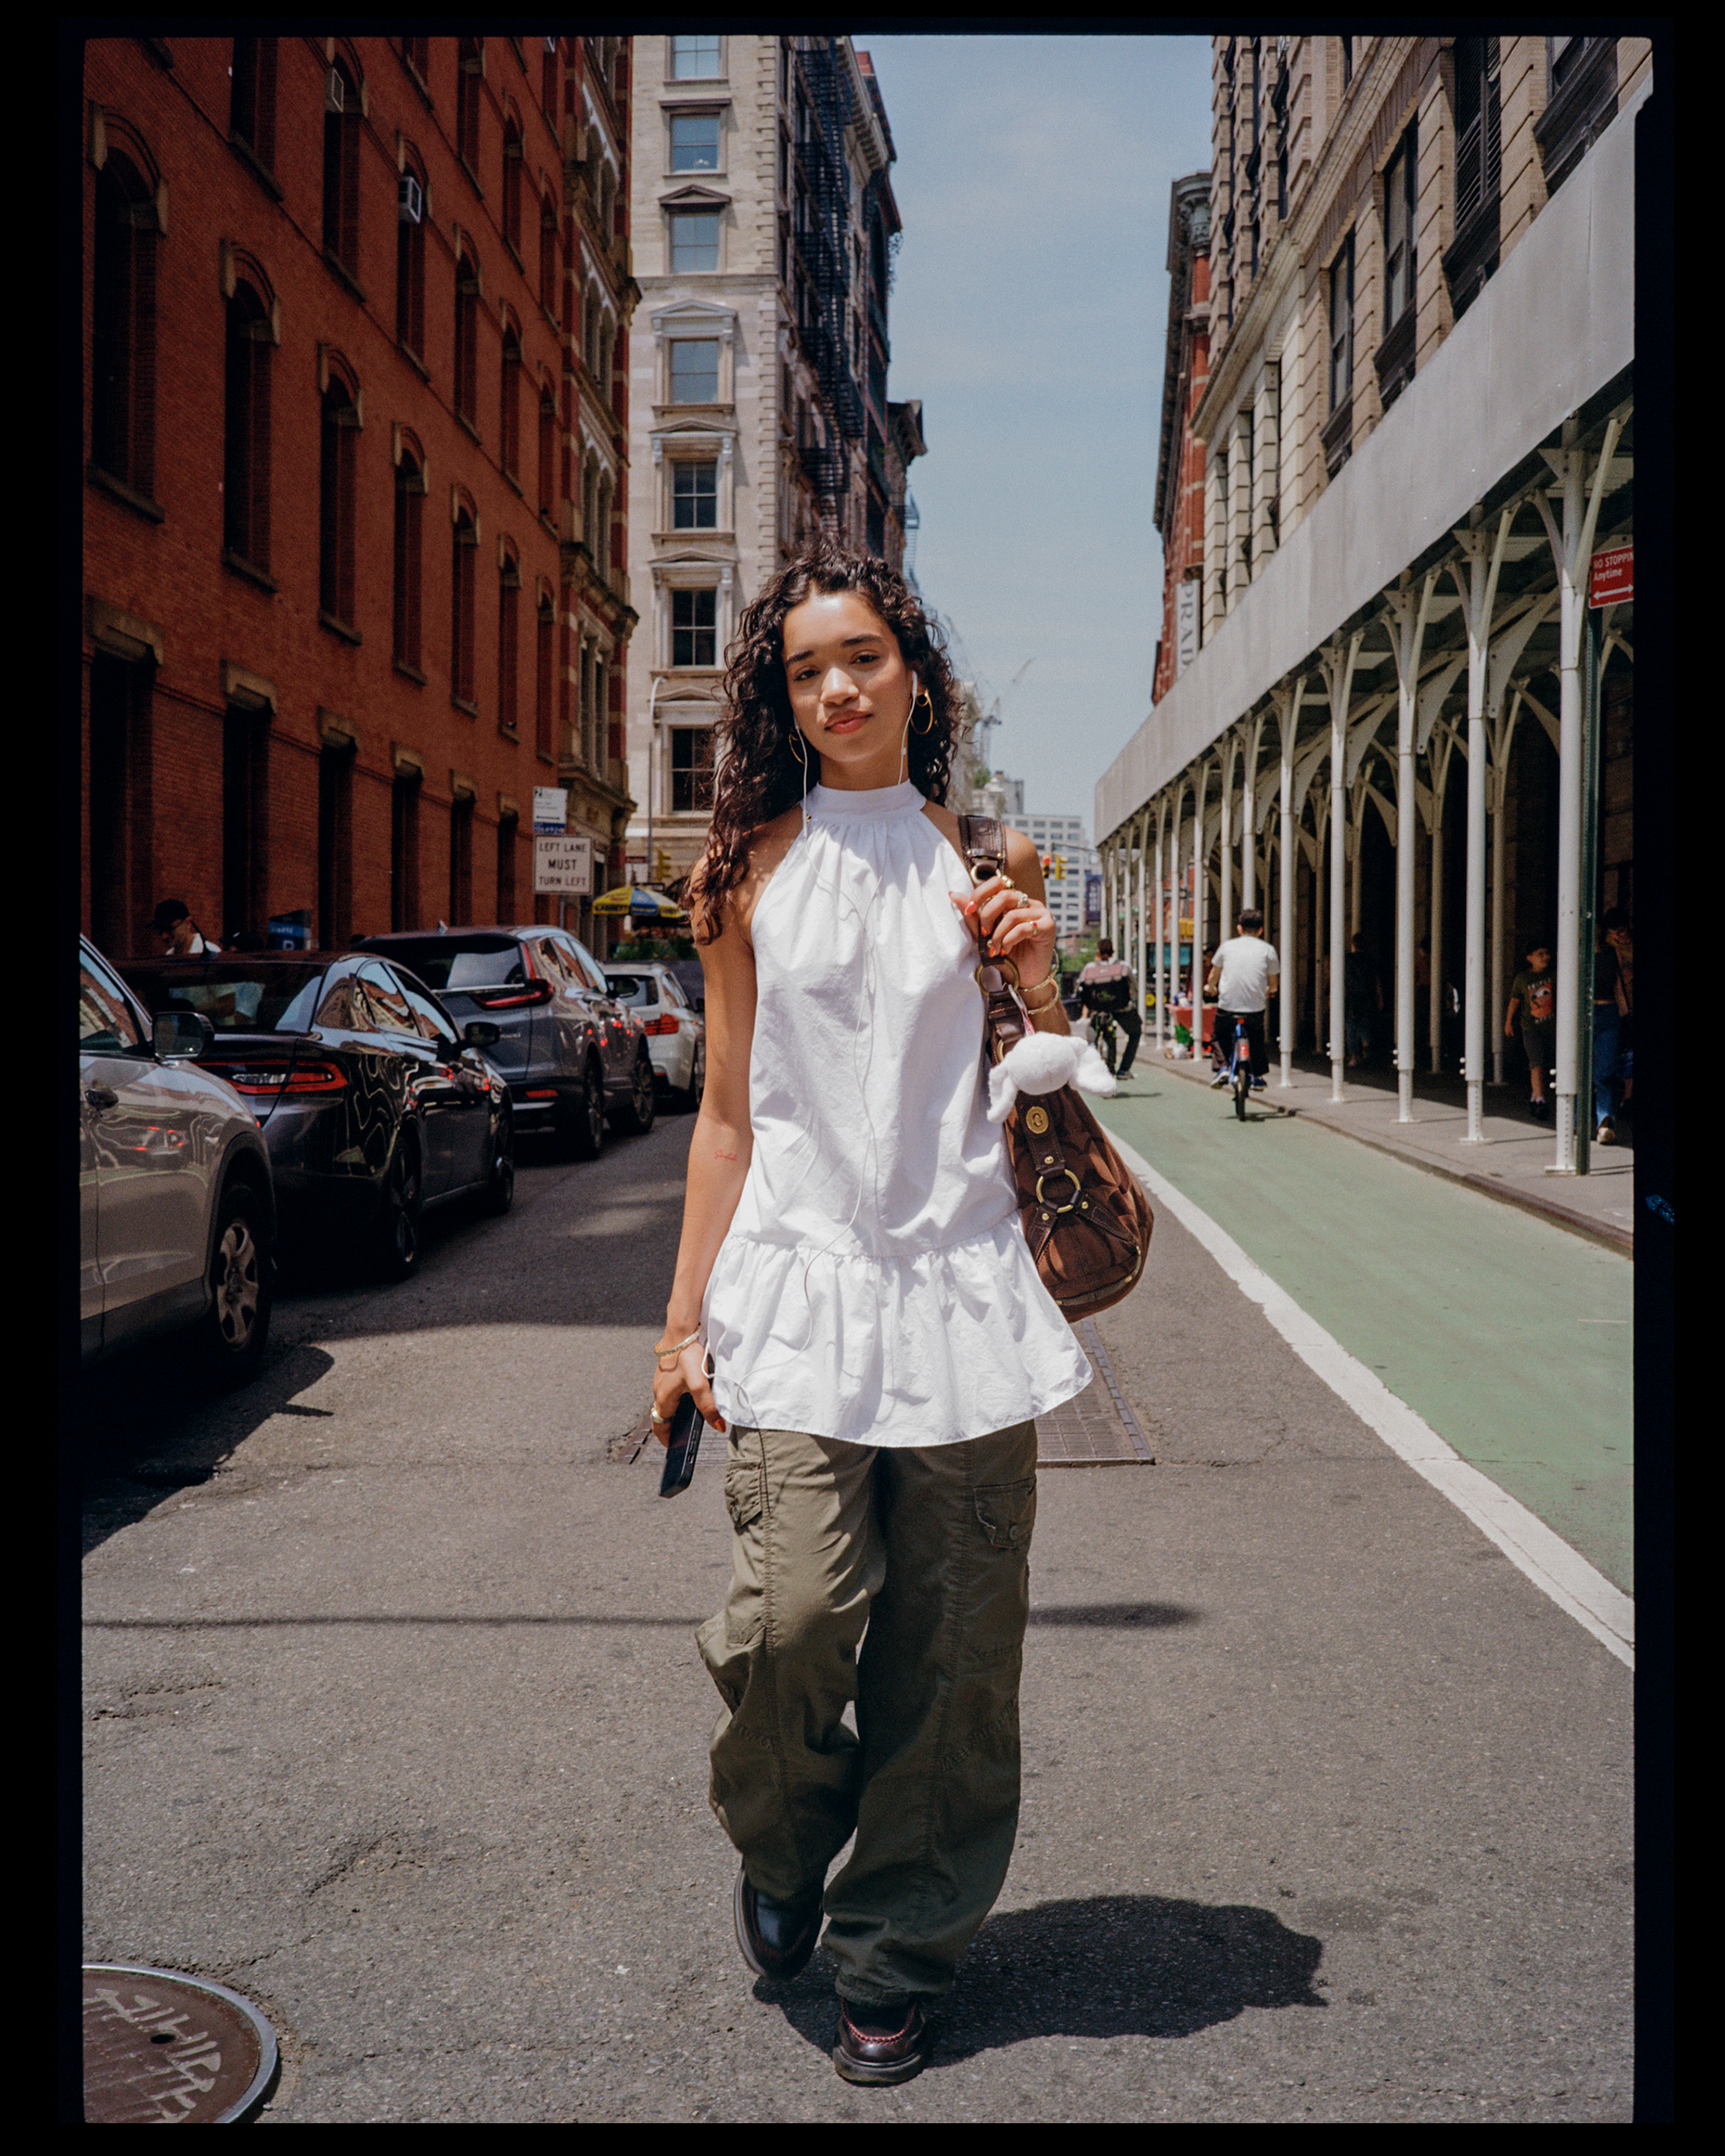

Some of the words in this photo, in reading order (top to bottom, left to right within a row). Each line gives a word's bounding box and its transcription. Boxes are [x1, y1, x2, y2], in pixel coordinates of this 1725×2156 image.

[1593, 558, 1603, 569] NO
[1593, 568, 1622, 581] Anytime
[1181, 581, 1194, 668] PRAD
[539, 843, 561, 852] LEFT
[564, 843, 587, 853] LANE
[548, 859, 577, 870] MUST
[539, 875, 561, 885] TURN
[566, 875, 586, 885] LEFT
